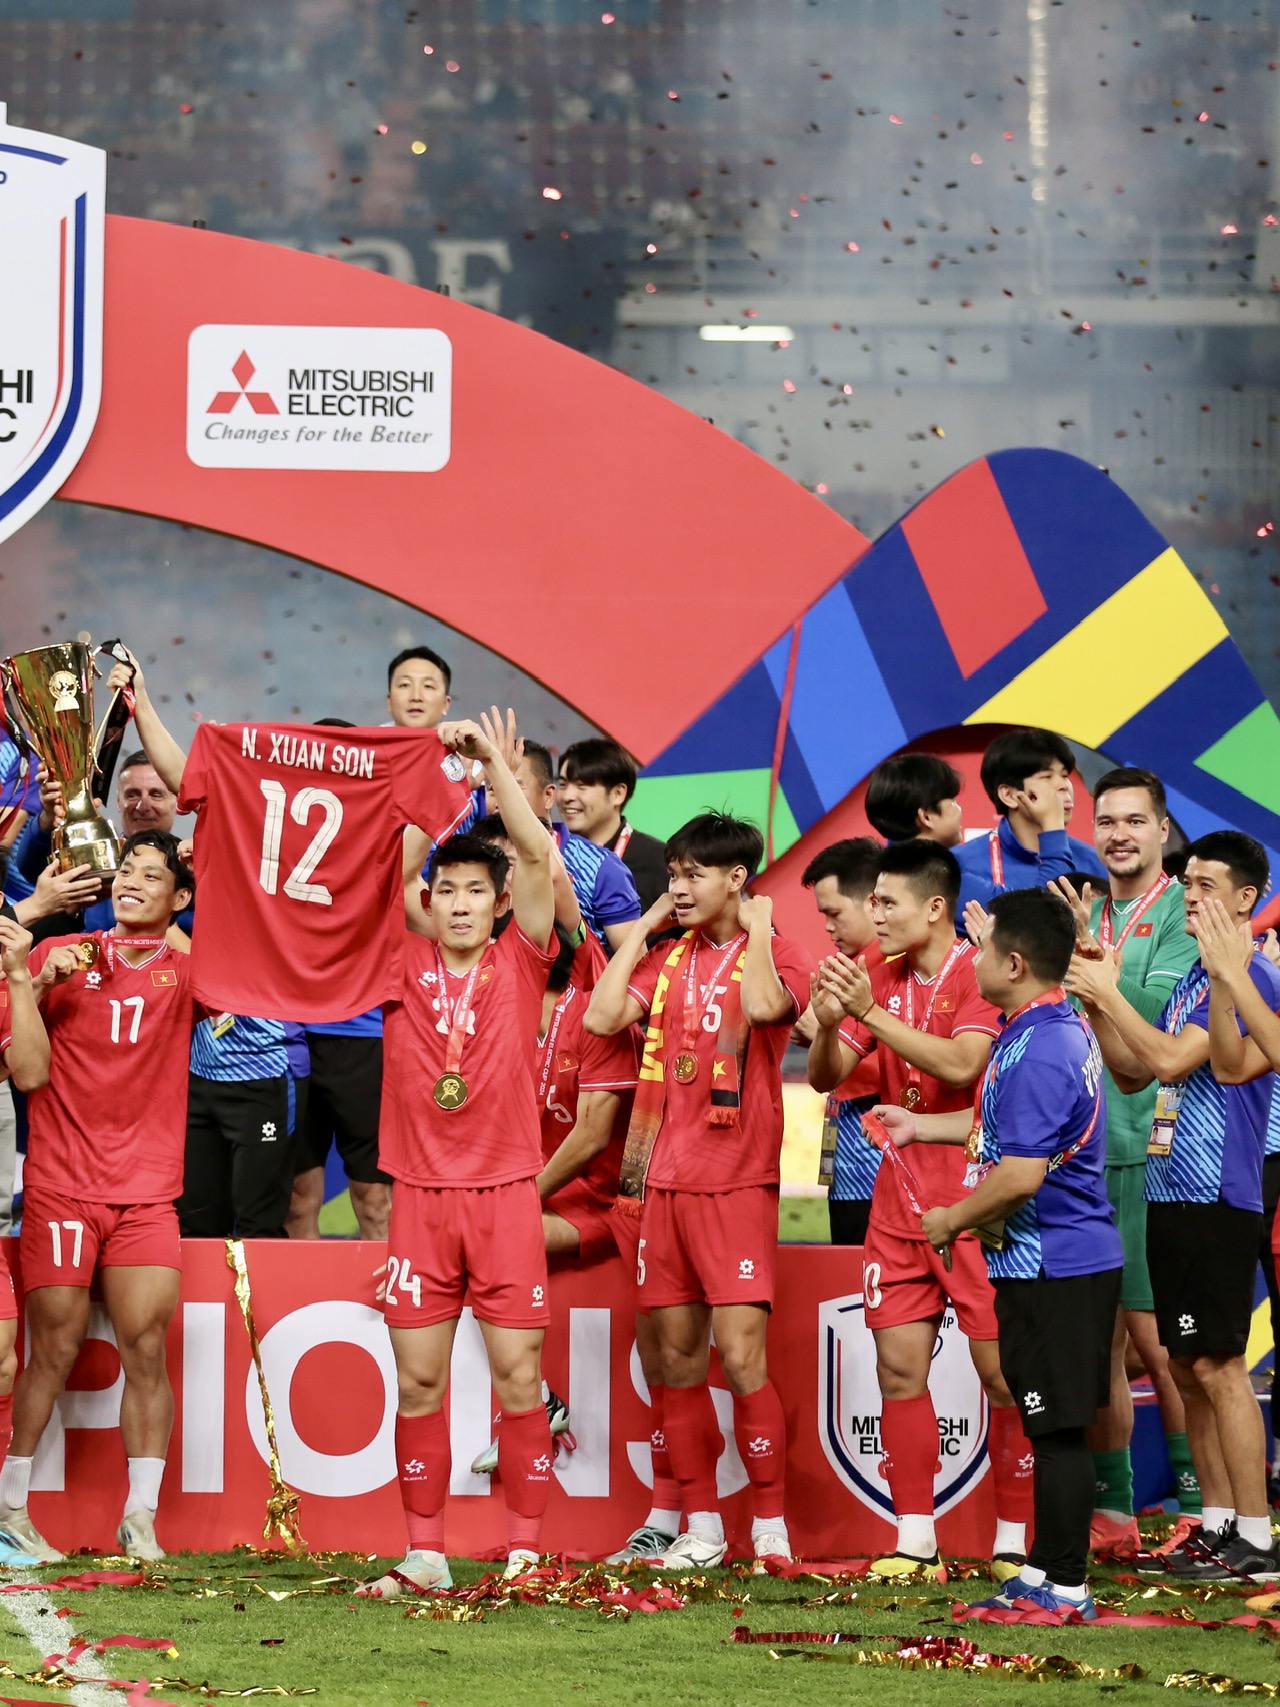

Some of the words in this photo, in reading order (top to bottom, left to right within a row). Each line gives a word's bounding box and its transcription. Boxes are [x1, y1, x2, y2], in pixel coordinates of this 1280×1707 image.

[288, 368, 434, 393] MITSUBISHI
[288, 394, 415, 417] ELECTRIC
[204, 422, 290, 444] Changes
[296, 425, 326, 443] for
[333, 427, 363, 442] the
[371, 425, 432, 443] Better
[241, 727, 262, 760] N.
[268, 732, 326, 771] XUAN
[331, 745, 376, 779] SON
[259, 779, 344, 905] 12
[109, 996, 145, 1044] 17
[545, 1042, 555, 1068] ELECTRIC
[48, 1220, 84, 1269] 17
[386, 1256, 422, 1308] 24
[852, 1415, 969, 1437] MITSHI
[859, 1436, 961, 1456] ELIC
